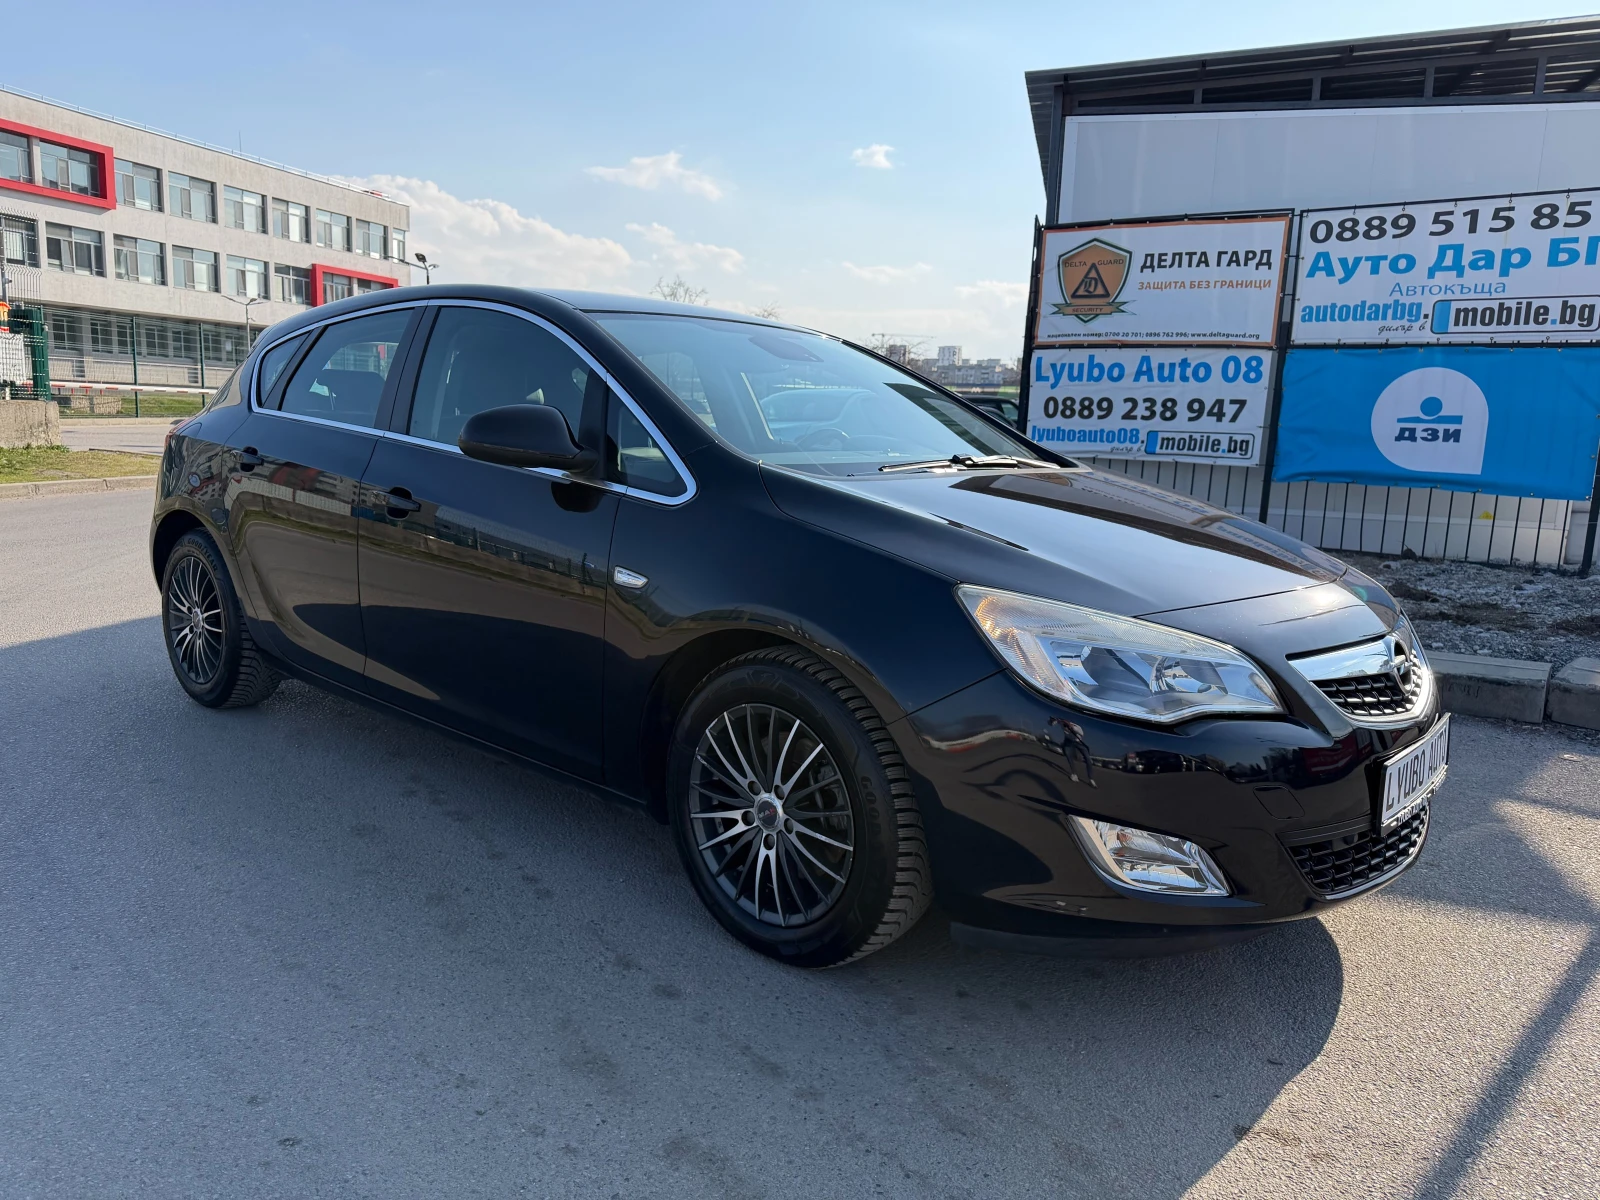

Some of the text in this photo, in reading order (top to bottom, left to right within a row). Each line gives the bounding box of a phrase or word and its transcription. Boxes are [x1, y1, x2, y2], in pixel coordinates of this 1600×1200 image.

[1309, 201, 1592, 243] 0889 515 85
[1064, 258, 1124, 268] DELTA GUARD
[1140, 249, 1272, 273] ДЕЛТА ГАРД
[1305, 251, 1417, 285] Ауто
[1427, 243, 1532, 280] Дар
[1138, 279, 1272, 291] ЗАЩИТА БЕЗ ГРАНИЦИ
[1389, 282, 1507, 298] Автокъща
[1454, 300, 1596, 328] mobile.bg
[1190, 331, 1260, 340] www.deltaguard.org
[1035, 354, 1264, 390] Lyubo Auto 08
[1043, 396, 1247, 423] 0889 238 947
[1159, 434, 1250, 456] mobile.bg
[1385, 748, 1426, 813] LYUBO
